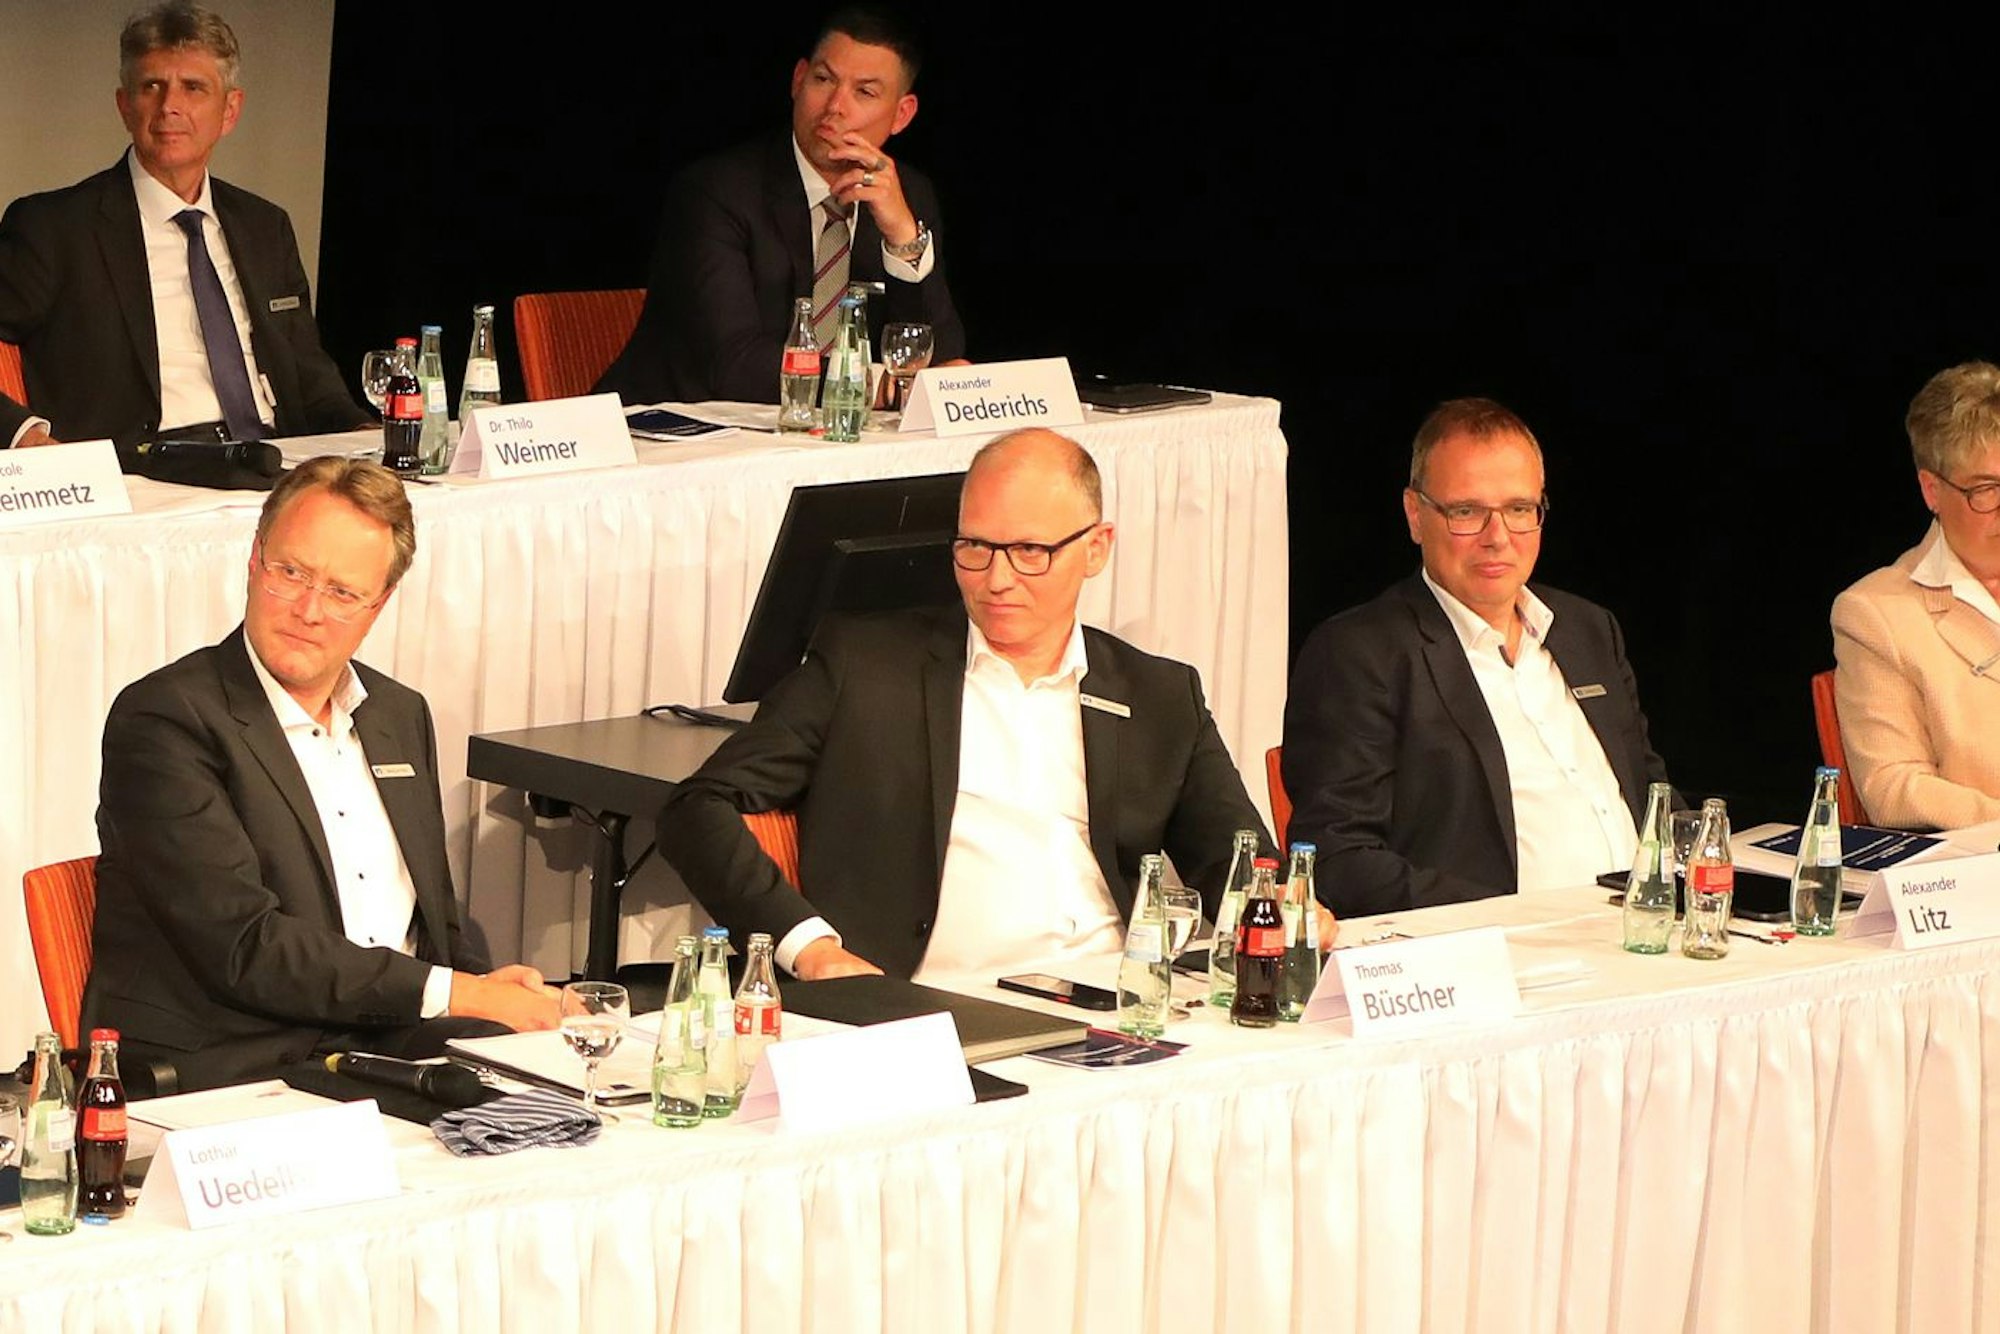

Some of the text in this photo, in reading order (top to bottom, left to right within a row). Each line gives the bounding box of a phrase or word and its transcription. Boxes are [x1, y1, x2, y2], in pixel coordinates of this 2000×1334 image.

[939, 377, 992, 391] Alexander
[944, 393, 1048, 423] Dederichs
[489, 417, 534, 433] Dr. Thilo
[495, 439, 577, 465] Weimer
[0, 483, 95, 511] einmetz
[1902, 876, 1956, 896] Alexander
[1908, 905, 1952, 933] Litz
[1354, 962, 1404, 980] Thomas
[1363, 983, 1455, 1020] Büscher
[188, 1143, 238, 1165] Lothar
